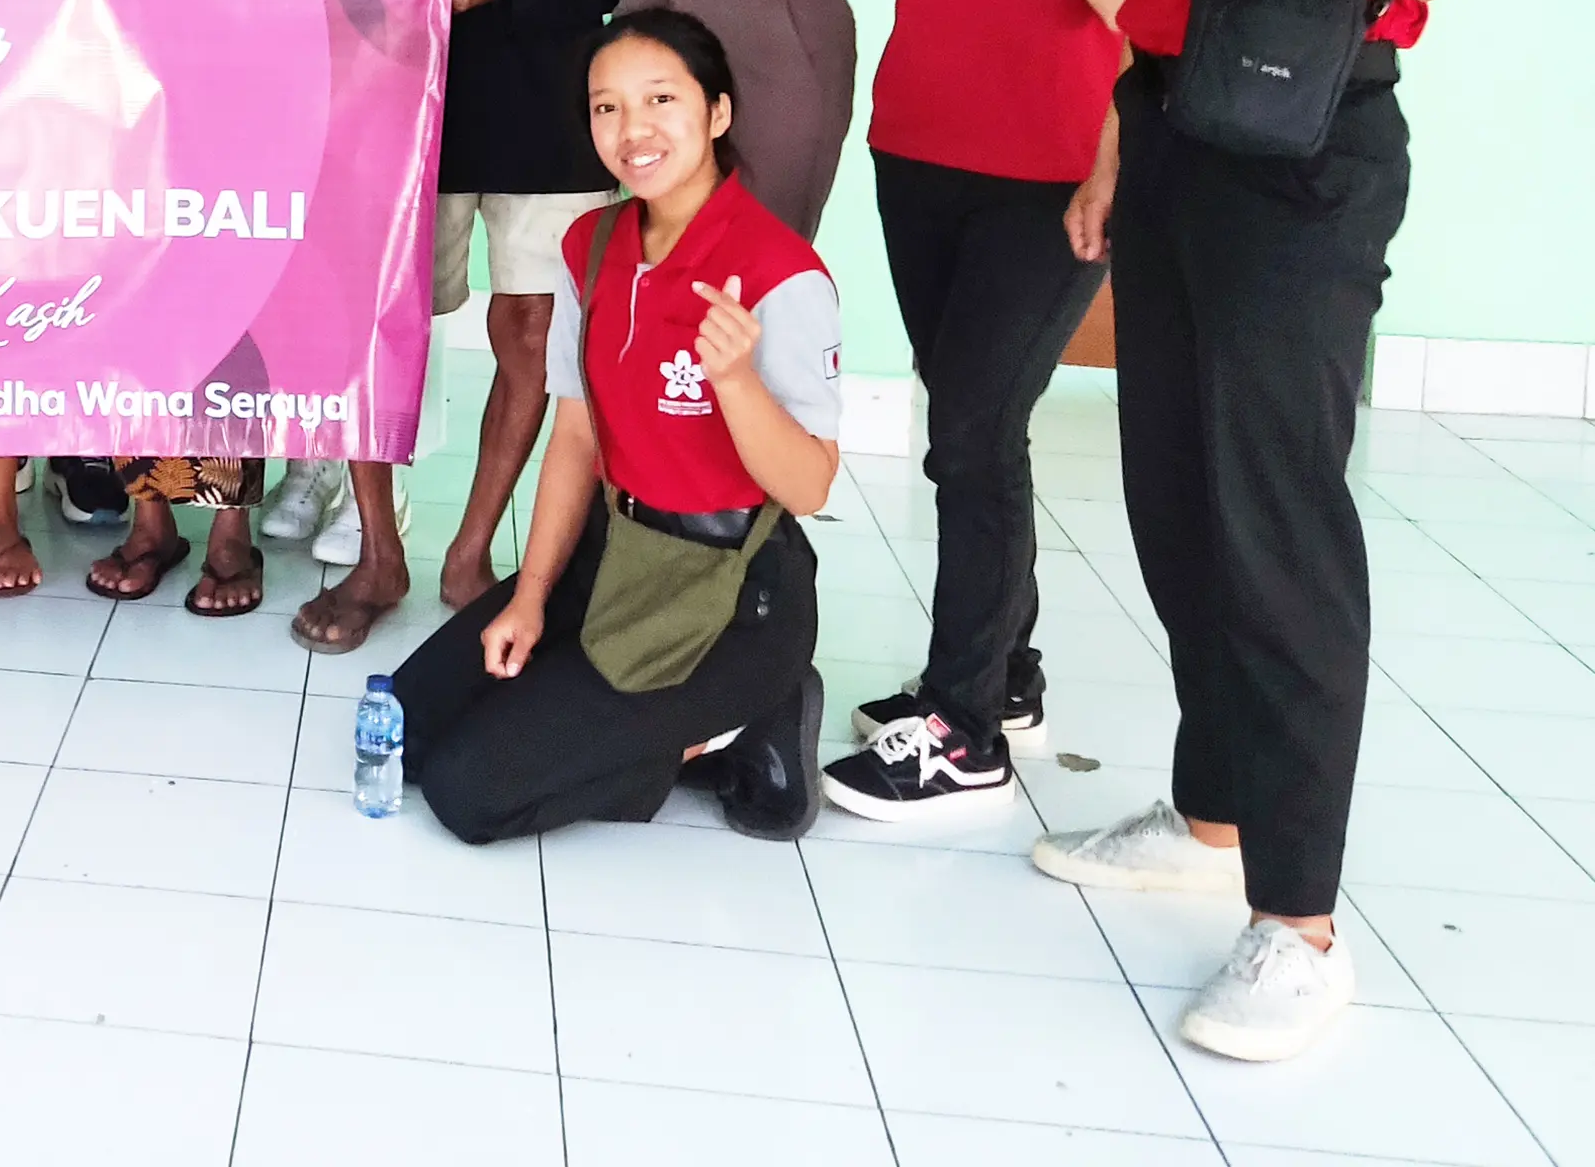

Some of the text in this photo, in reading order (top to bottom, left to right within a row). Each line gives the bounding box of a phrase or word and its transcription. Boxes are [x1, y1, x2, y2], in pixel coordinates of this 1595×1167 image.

[164, 189, 305, 241] BALI
[78, 380, 194, 419] Wana
[204, 382, 349, 432] Seraya
